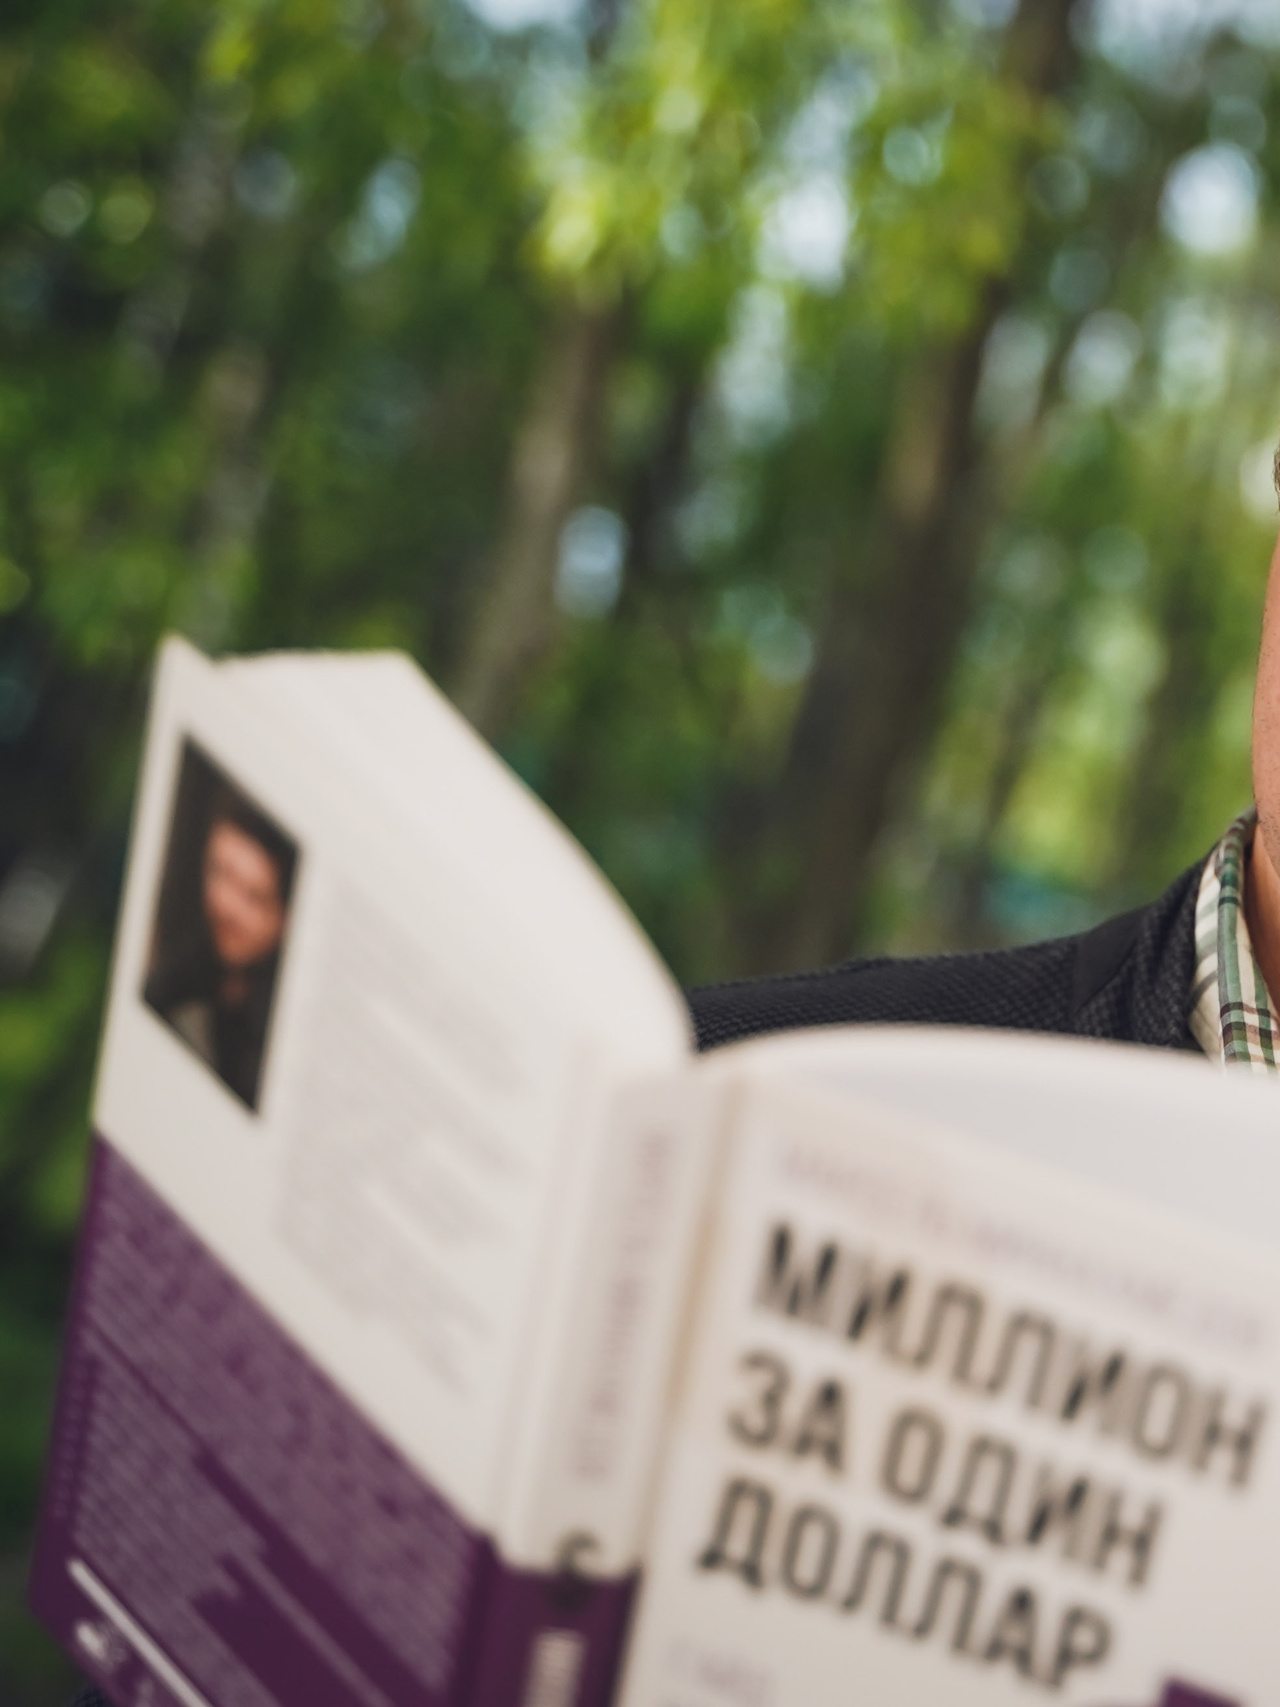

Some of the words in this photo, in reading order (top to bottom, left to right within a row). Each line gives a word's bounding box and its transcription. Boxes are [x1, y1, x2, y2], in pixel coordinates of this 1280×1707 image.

[727, 1350, 846, 1477] ЗА
[882, 1406, 1163, 1592] ОДИН
[755, 1218, 1267, 1490] МИЛЛИОН
[696, 1475, 1112, 1691] ДОЛЛАР
